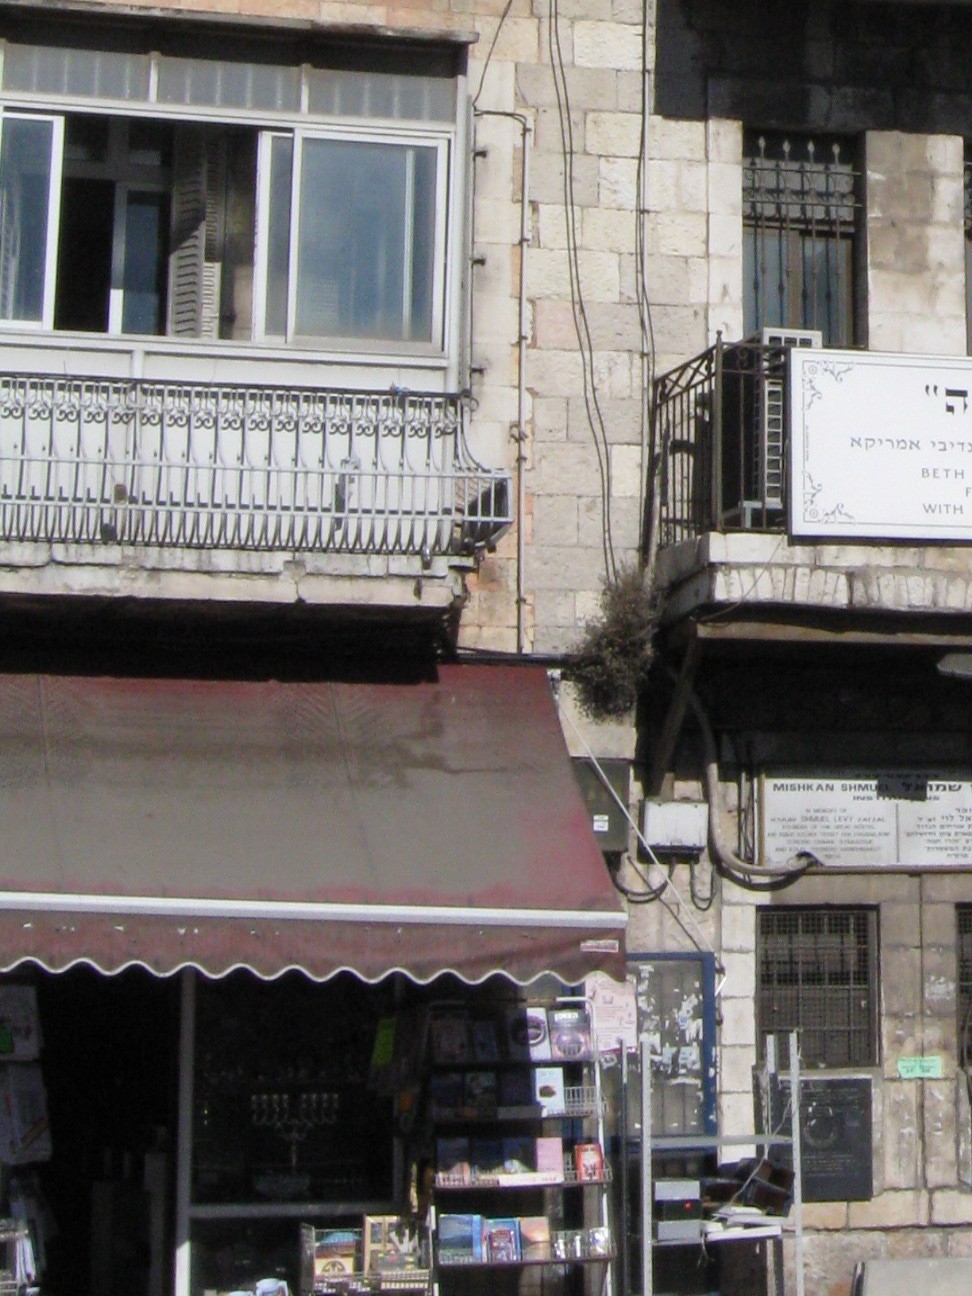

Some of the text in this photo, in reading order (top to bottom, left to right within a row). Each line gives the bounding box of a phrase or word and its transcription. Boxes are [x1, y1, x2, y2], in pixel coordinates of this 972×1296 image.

[850, 436, 920, 452] אמריקא
[931, 440, 972, 453] נדיבי
[922, 467, 964, 480] BETH
[923, 503, 963, 515] WITH
[773, 783, 834, 792] MISHKAN
